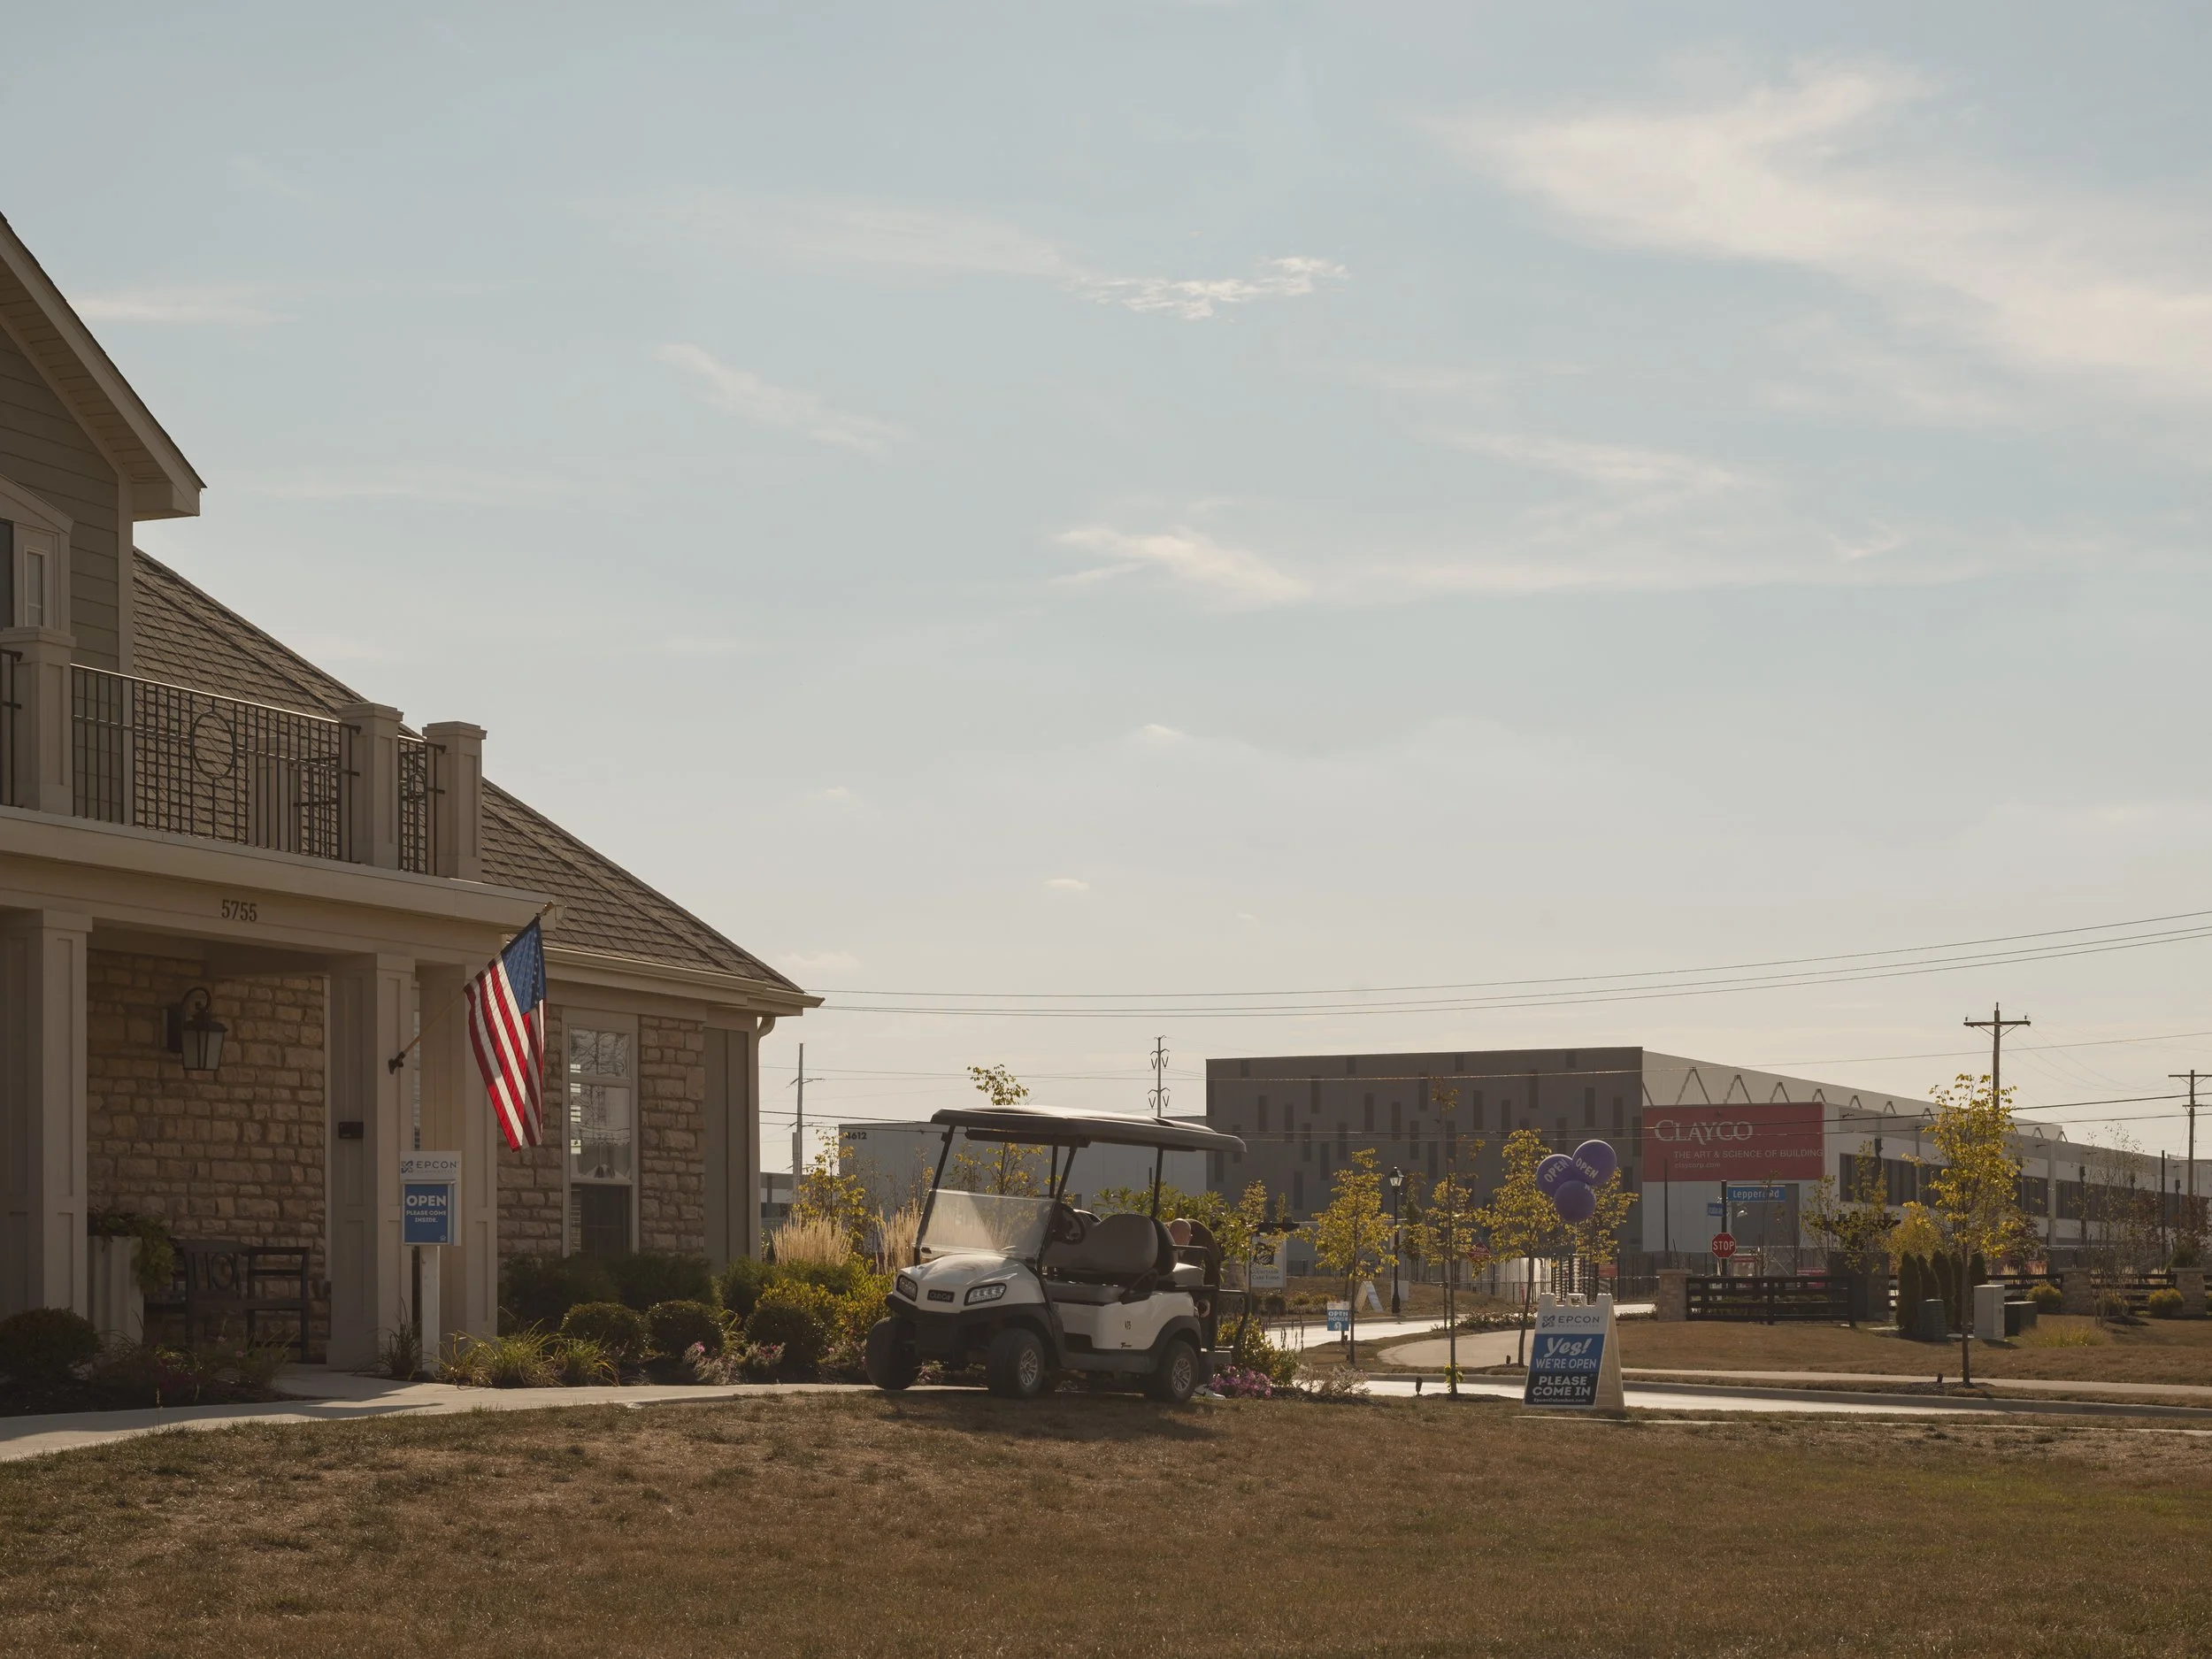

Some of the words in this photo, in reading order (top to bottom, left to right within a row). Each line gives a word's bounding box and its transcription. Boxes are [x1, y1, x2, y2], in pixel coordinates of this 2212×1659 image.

[221, 899, 257, 922] 5755
[1654, 1119, 1754, 1145] CLAYCO
[1674, 1150, 1691, 1159] THE
[1694, 1150, 1710, 1159] ART
[1723, 1149, 1762, 1158] SCIENCE
[1764, 1149, 1777, 1158] OF
[1779, 1148, 1824, 1157] BUILDING
[1543, 1158, 1570, 1183] OPEN
[1575, 1157, 1600, 1179] OPEN
[1769, 1189, 1779, 1198] Rd
[406, 1194, 447, 1207] OPEN
[1713, 1240, 1734, 1251] STOP
[1543, 1337, 1593, 1357] Yes!
[1536, 1358, 1567, 1369] WE'RE
[1569, 1358, 1597, 1369] OPEN
[1539, 1376, 1587, 1386] PLEASE
[1532, 1386, 1571, 1396] COME
[1574, 1386, 1591, 1396] IN
